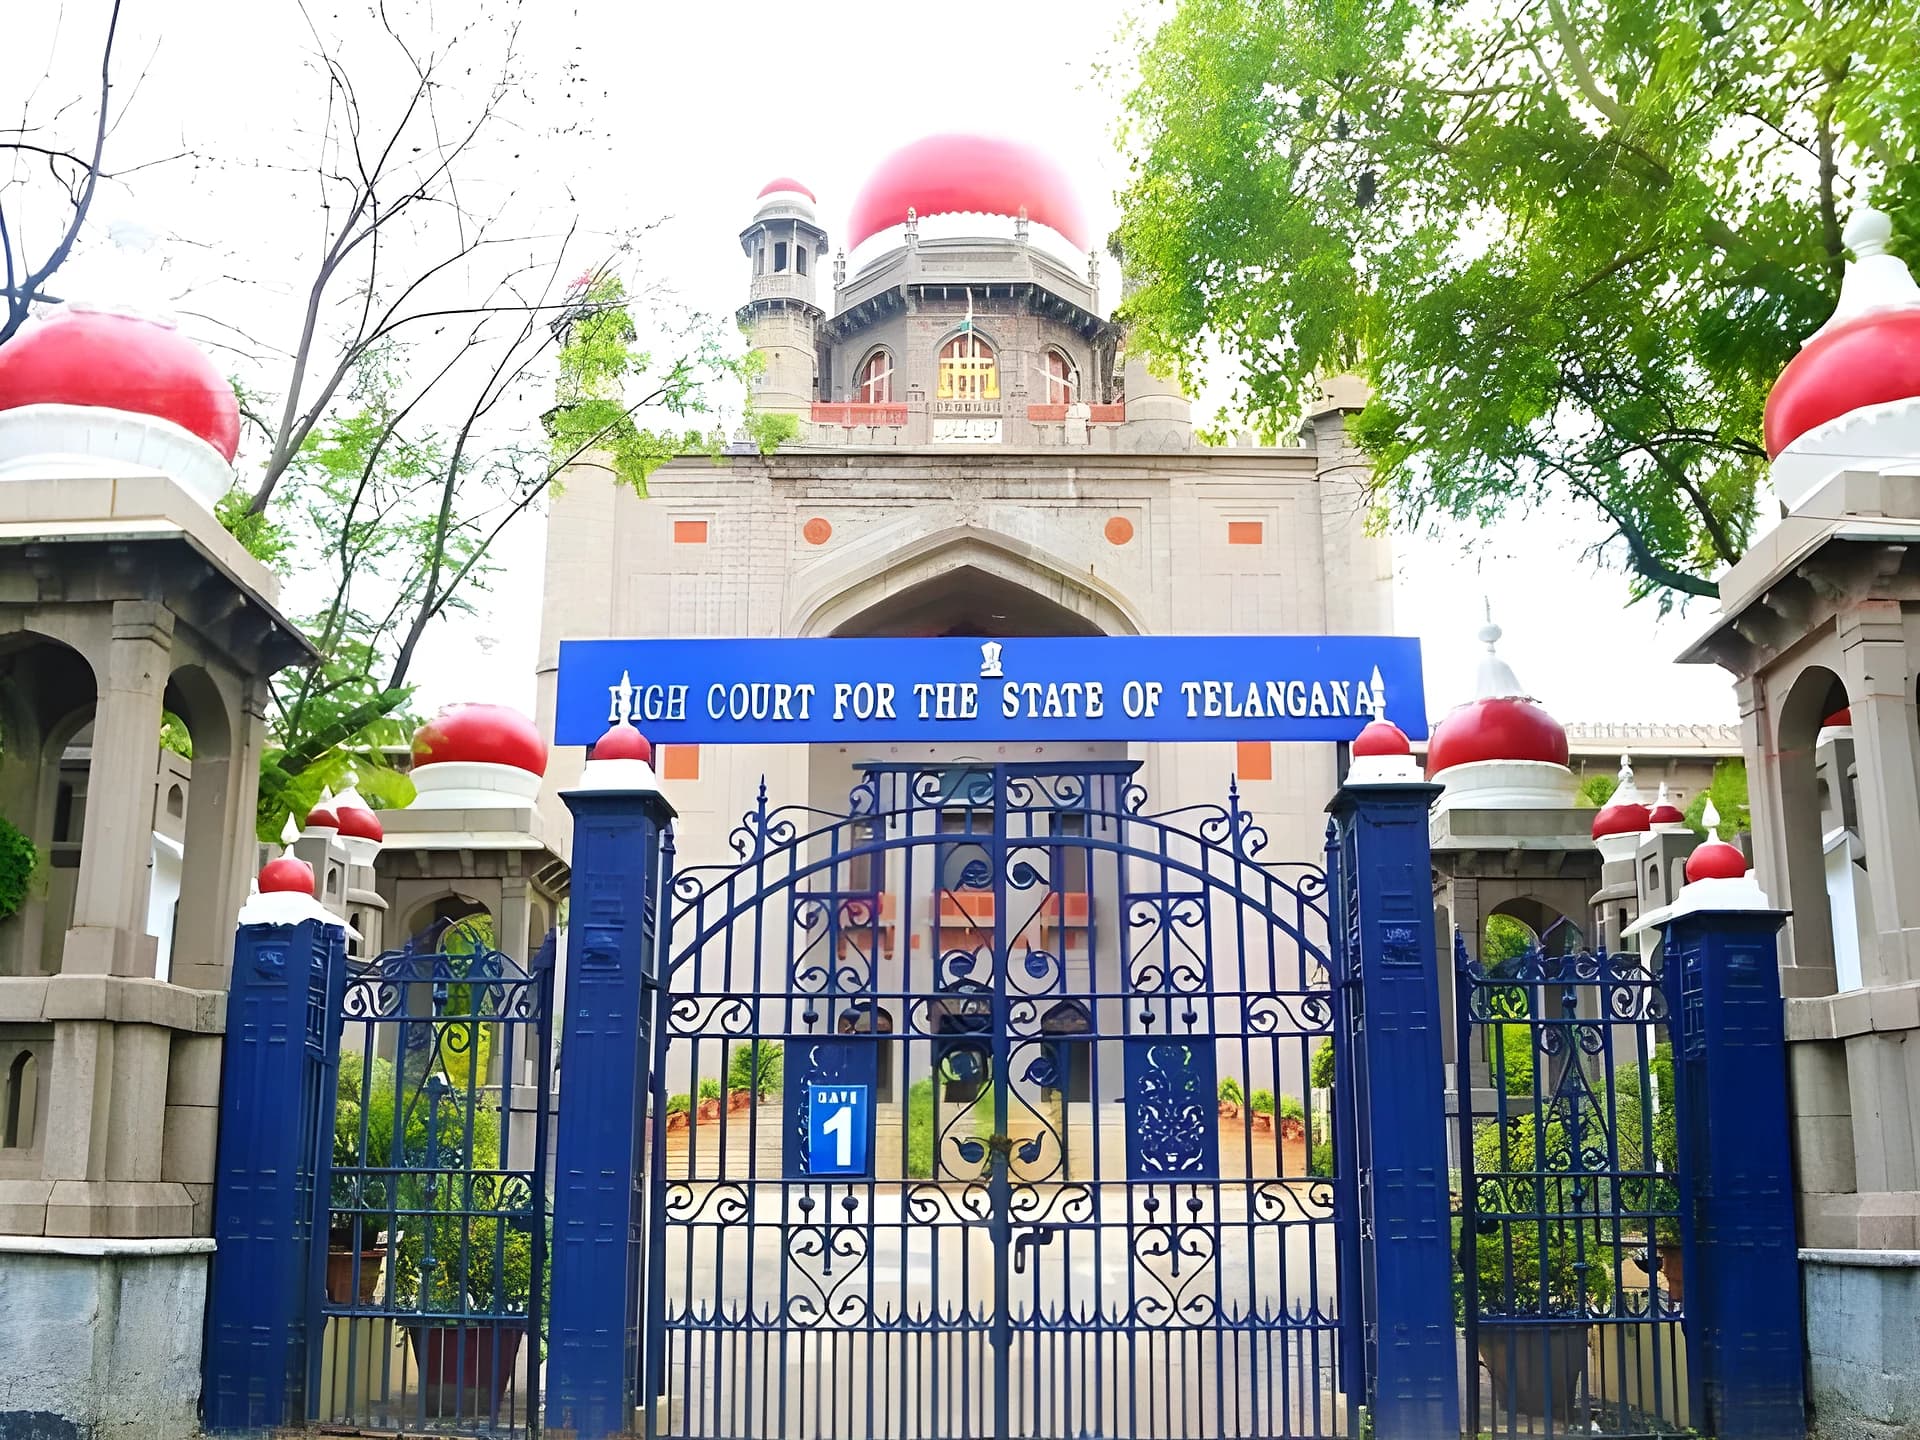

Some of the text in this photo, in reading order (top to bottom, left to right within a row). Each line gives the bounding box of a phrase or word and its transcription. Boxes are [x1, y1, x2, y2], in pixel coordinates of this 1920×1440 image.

[706, 682, 815, 721] COURT
[831, 682, 897, 721] FOR
[913, 683, 979, 720] THE
[1001, 681, 1104, 719] STATE
[1121, 680, 1164, 719] OF
[1181, 680, 1376, 718] TELANGANA
[823, 1106, 852, 1166] 1
